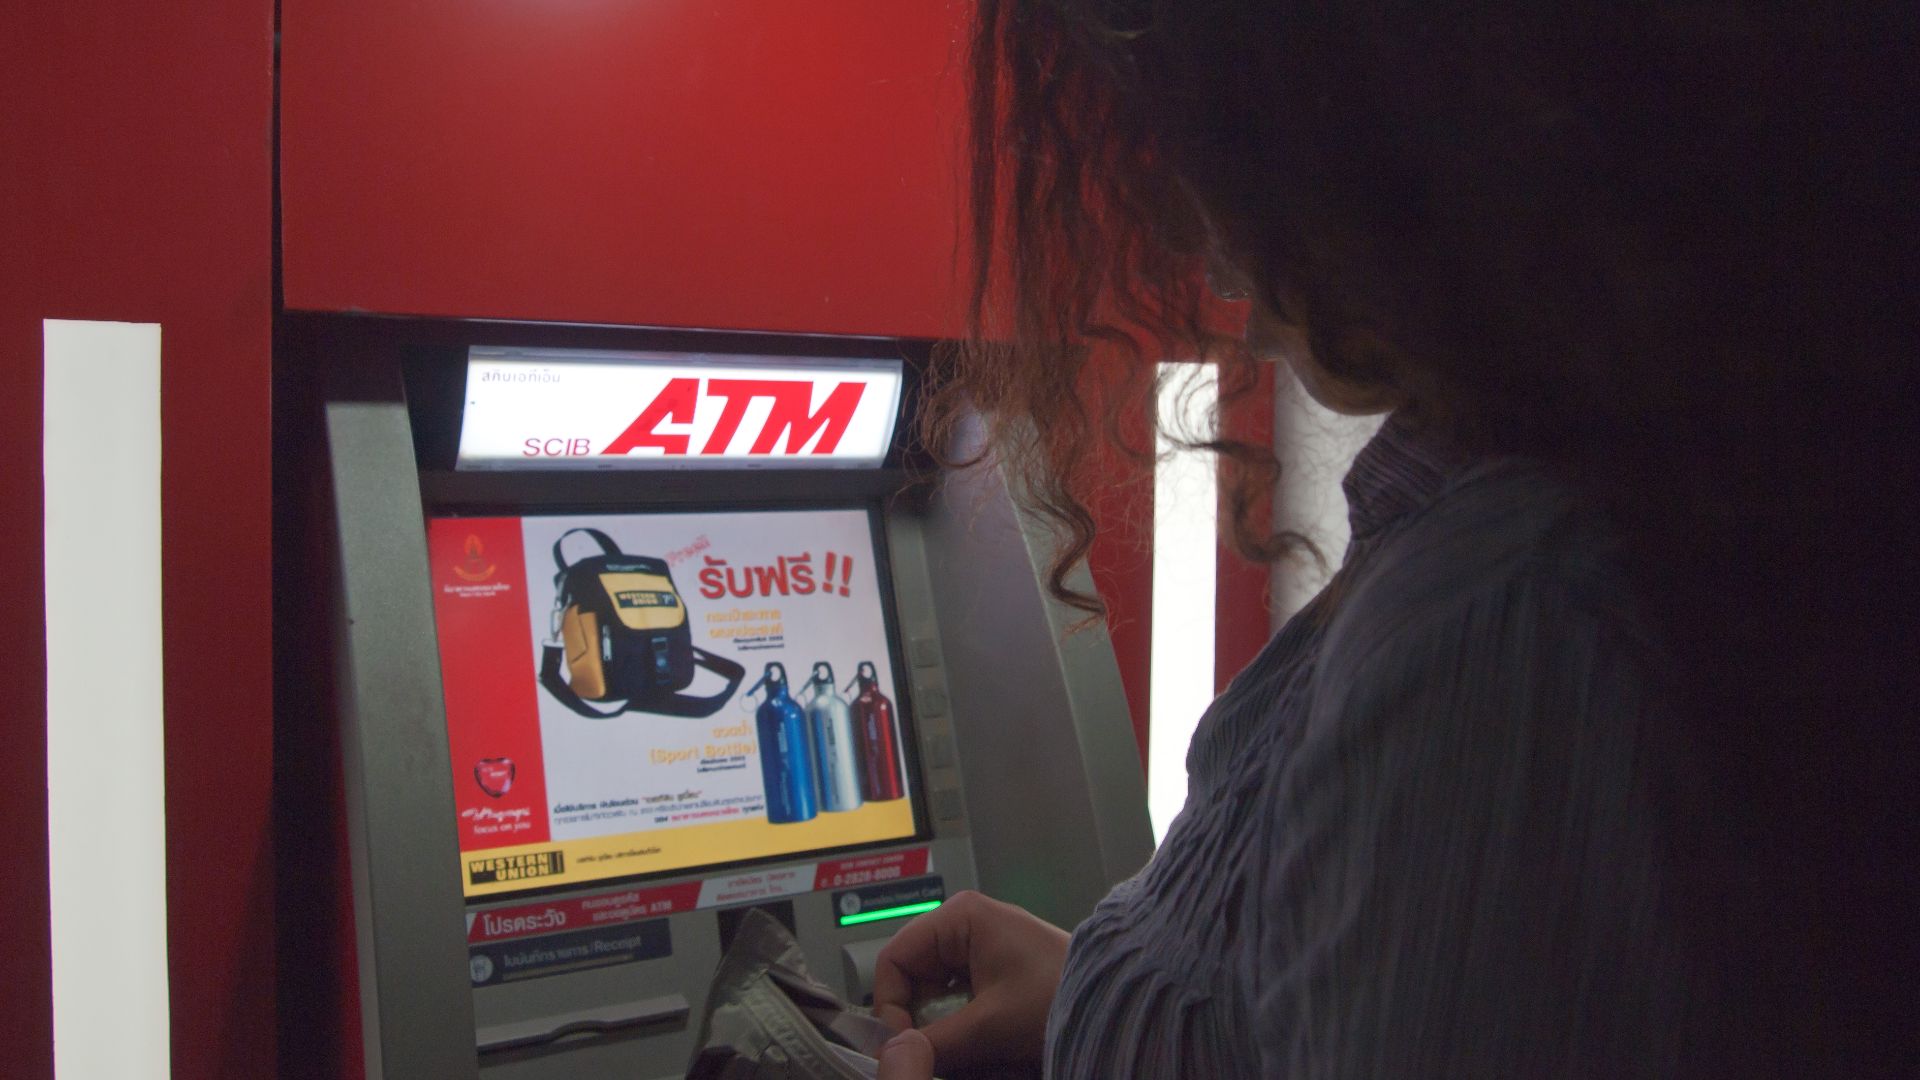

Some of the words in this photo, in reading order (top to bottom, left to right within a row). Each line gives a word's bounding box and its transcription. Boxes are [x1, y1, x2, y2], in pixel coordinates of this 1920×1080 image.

[522, 438, 590, 456] SCIB
[600, 378, 867, 455] ATM
[470, 853, 549, 873] WESTERN
[496, 864, 550, 881] UNION
